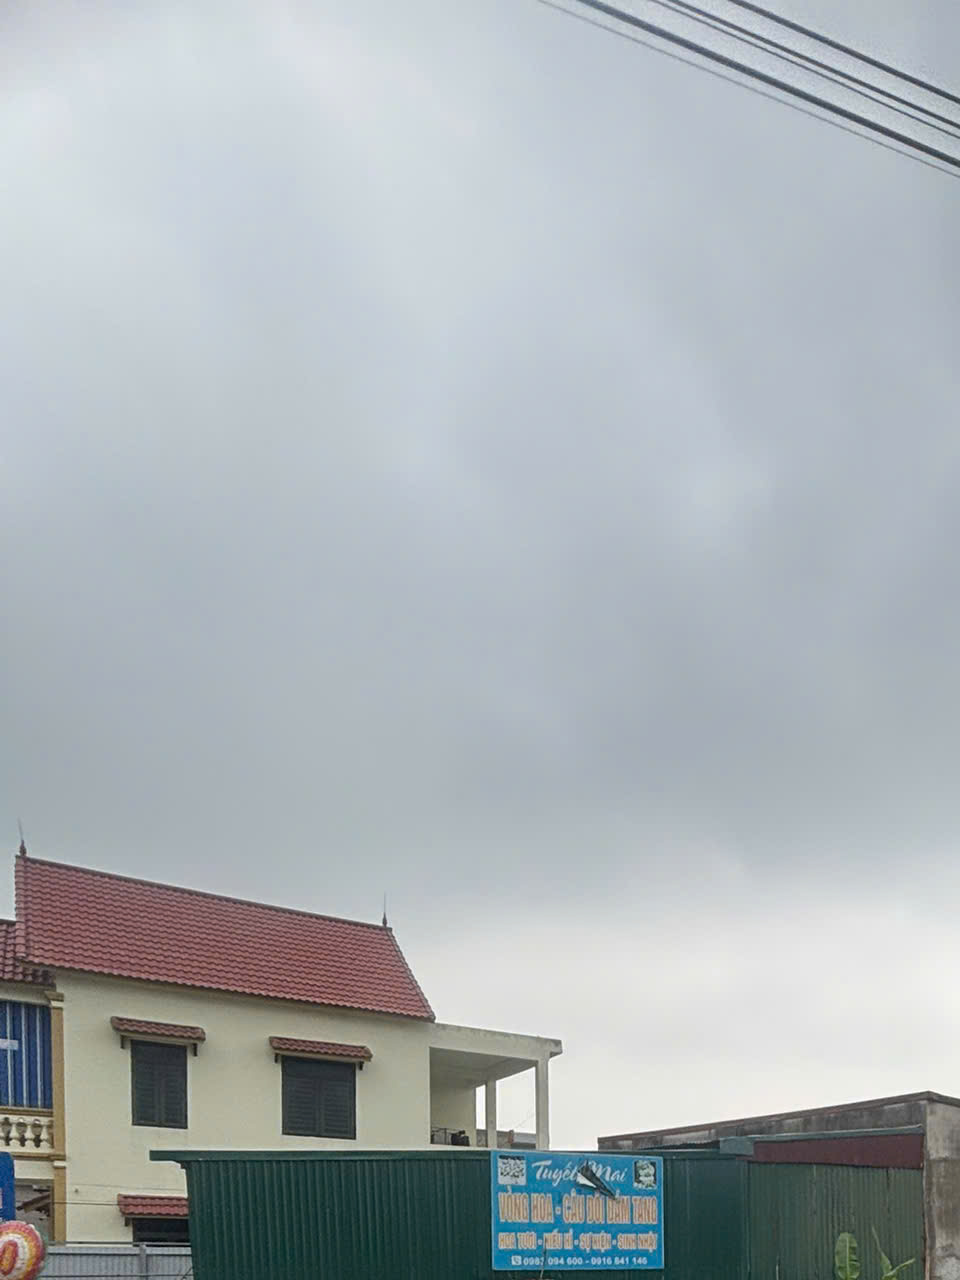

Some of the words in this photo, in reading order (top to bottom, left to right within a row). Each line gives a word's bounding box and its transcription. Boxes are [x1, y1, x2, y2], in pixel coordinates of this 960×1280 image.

[532, 1160, 577, 1187] Tuyết
[587, 1159, 627, 1182] Mai
[531, 1193, 554, 1223] HOA
[632, 1196, 658, 1225] TANG
[498, 1231, 516, 1250] HOA
[617, 1232, 637, 1250] SINH
